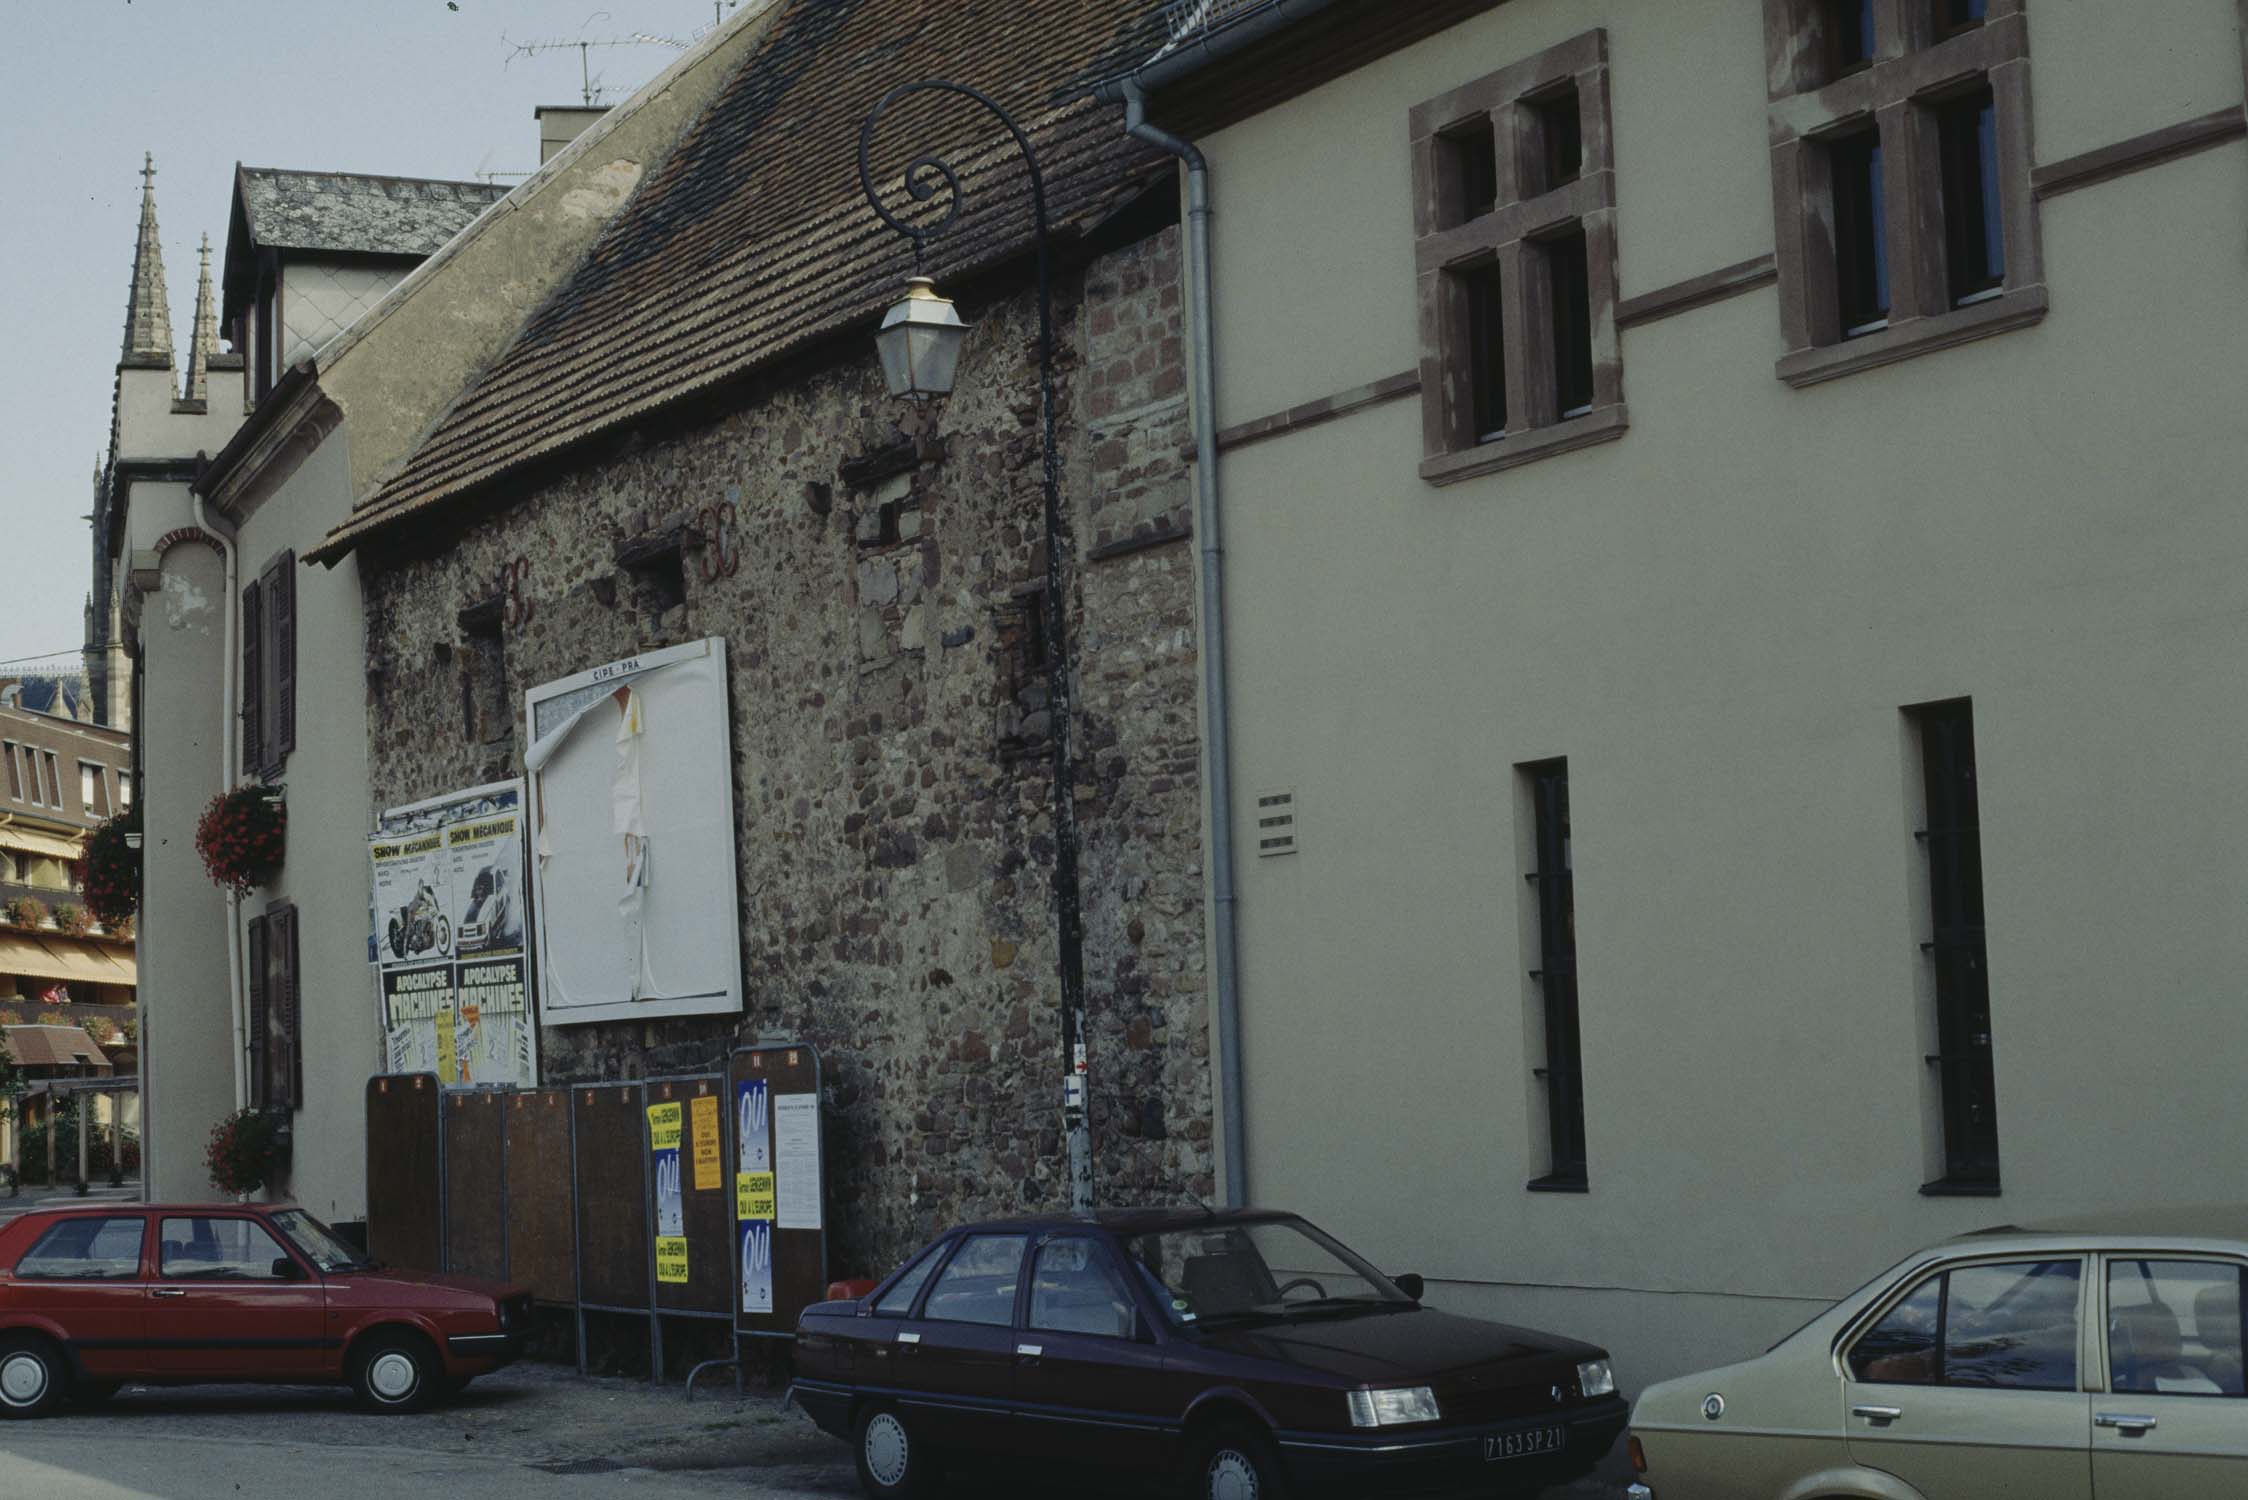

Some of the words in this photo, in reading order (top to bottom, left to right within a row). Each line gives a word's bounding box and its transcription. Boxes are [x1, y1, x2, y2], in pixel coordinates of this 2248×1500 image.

[593, 667, 614, 682] CIPE
[622, 659, 640, 673] PRA
[449, 829, 470, 843] SHOW
[373, 845, 400, 859] SHOW
[396, 971, 447, 992] APOCALYPSE
[464, 965, 517, 985] APOCALYPSE
[389, 988, 454, 1020] MACHINES
[457, 983, 525, 1015] MACHINES
[1487, 1433, 1523, 1457] 7163
[1526, 1430, 1543, 1451] SP
[1546, 1427, 1561, 1448] 21
